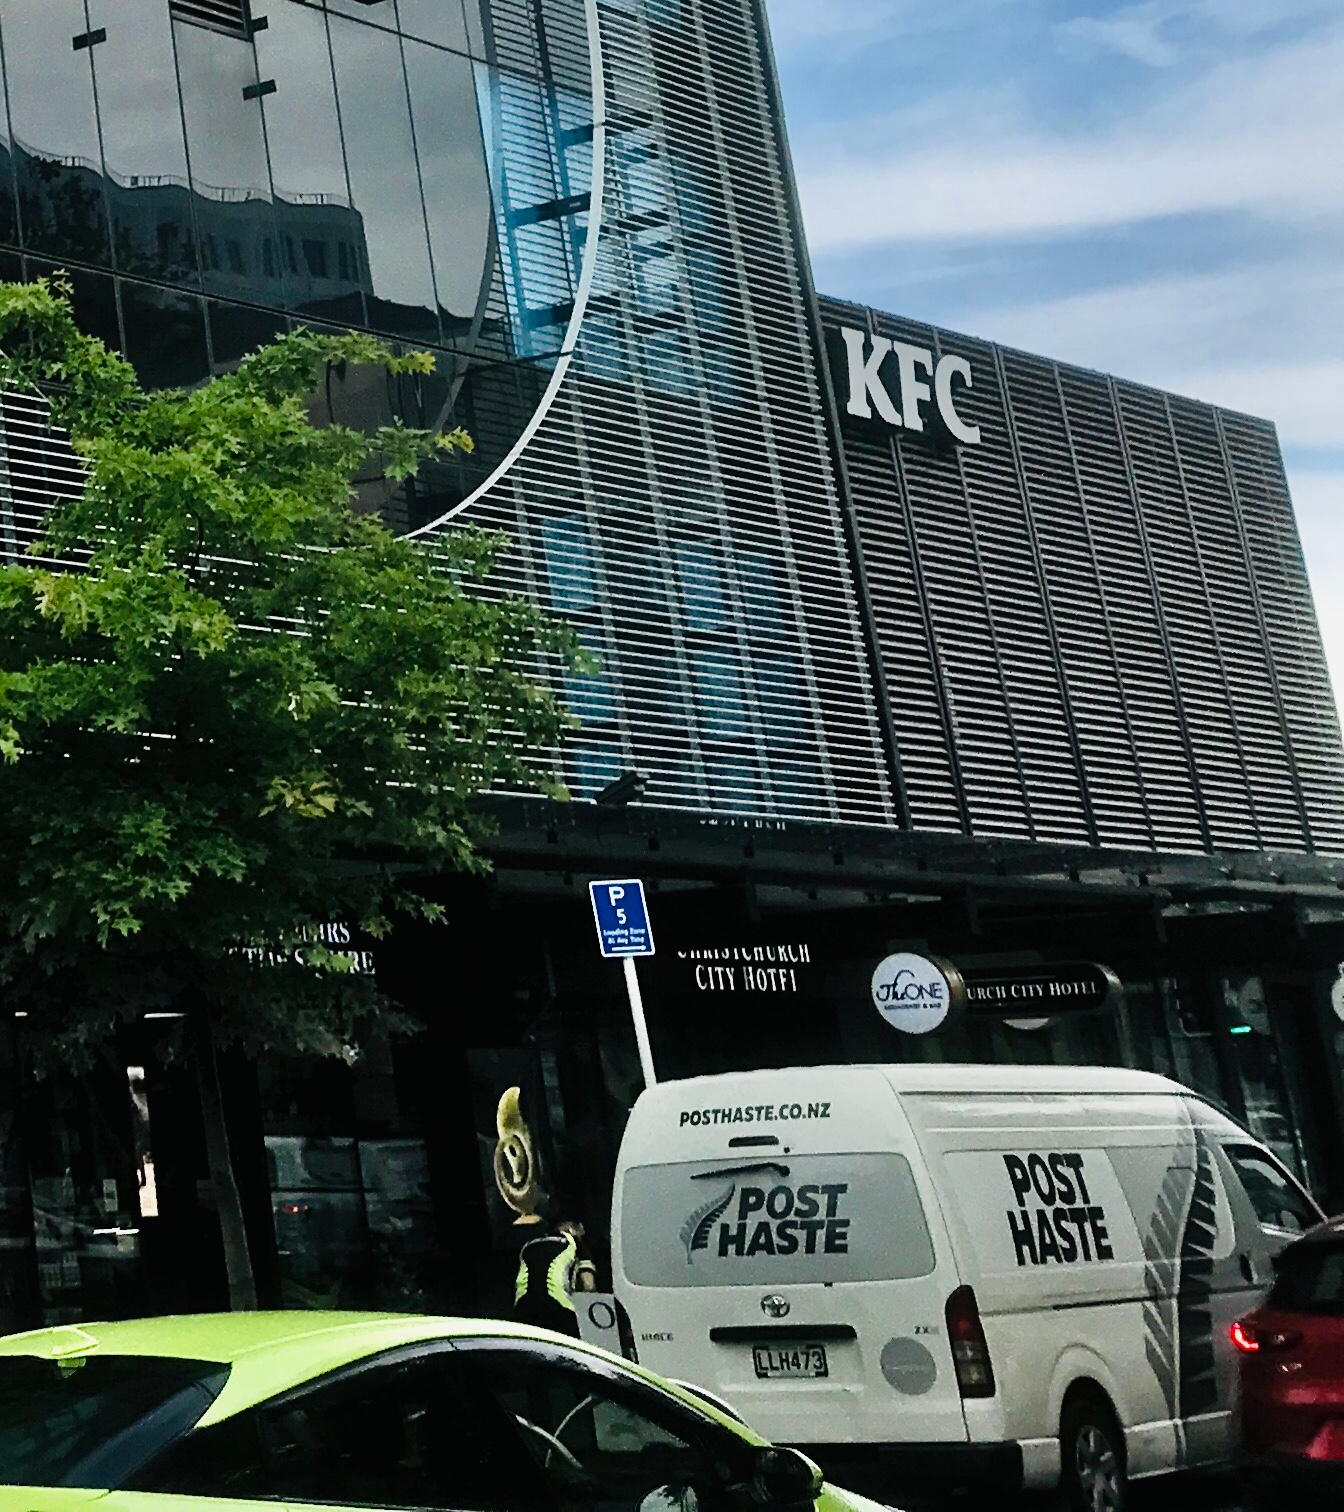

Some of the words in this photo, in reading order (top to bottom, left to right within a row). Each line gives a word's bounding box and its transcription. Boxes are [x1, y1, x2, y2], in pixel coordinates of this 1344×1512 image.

[841, 326, 981, 444] KFC
[608, 886, 625, 906] P
[616, 908, 627, 925] 5
[695, 964, 735, 991] CITY
[1011, 984, 1045, 998] CITY
[1049, 980, 1097, 995] HOTEL
[905, 982, 944, 1001] ONE
[680, 1102, 831, 1127] POSTHASTE.CO.NZ
[1002, 1152, 1090, 1207] POST
[738, 1183, 848, 1221] POST
[718, 1219, 850, 1257] HASTE
[1007, 1206, 1114, 1266] HASTE
[757, 1351, 824, 1371] LLH473
